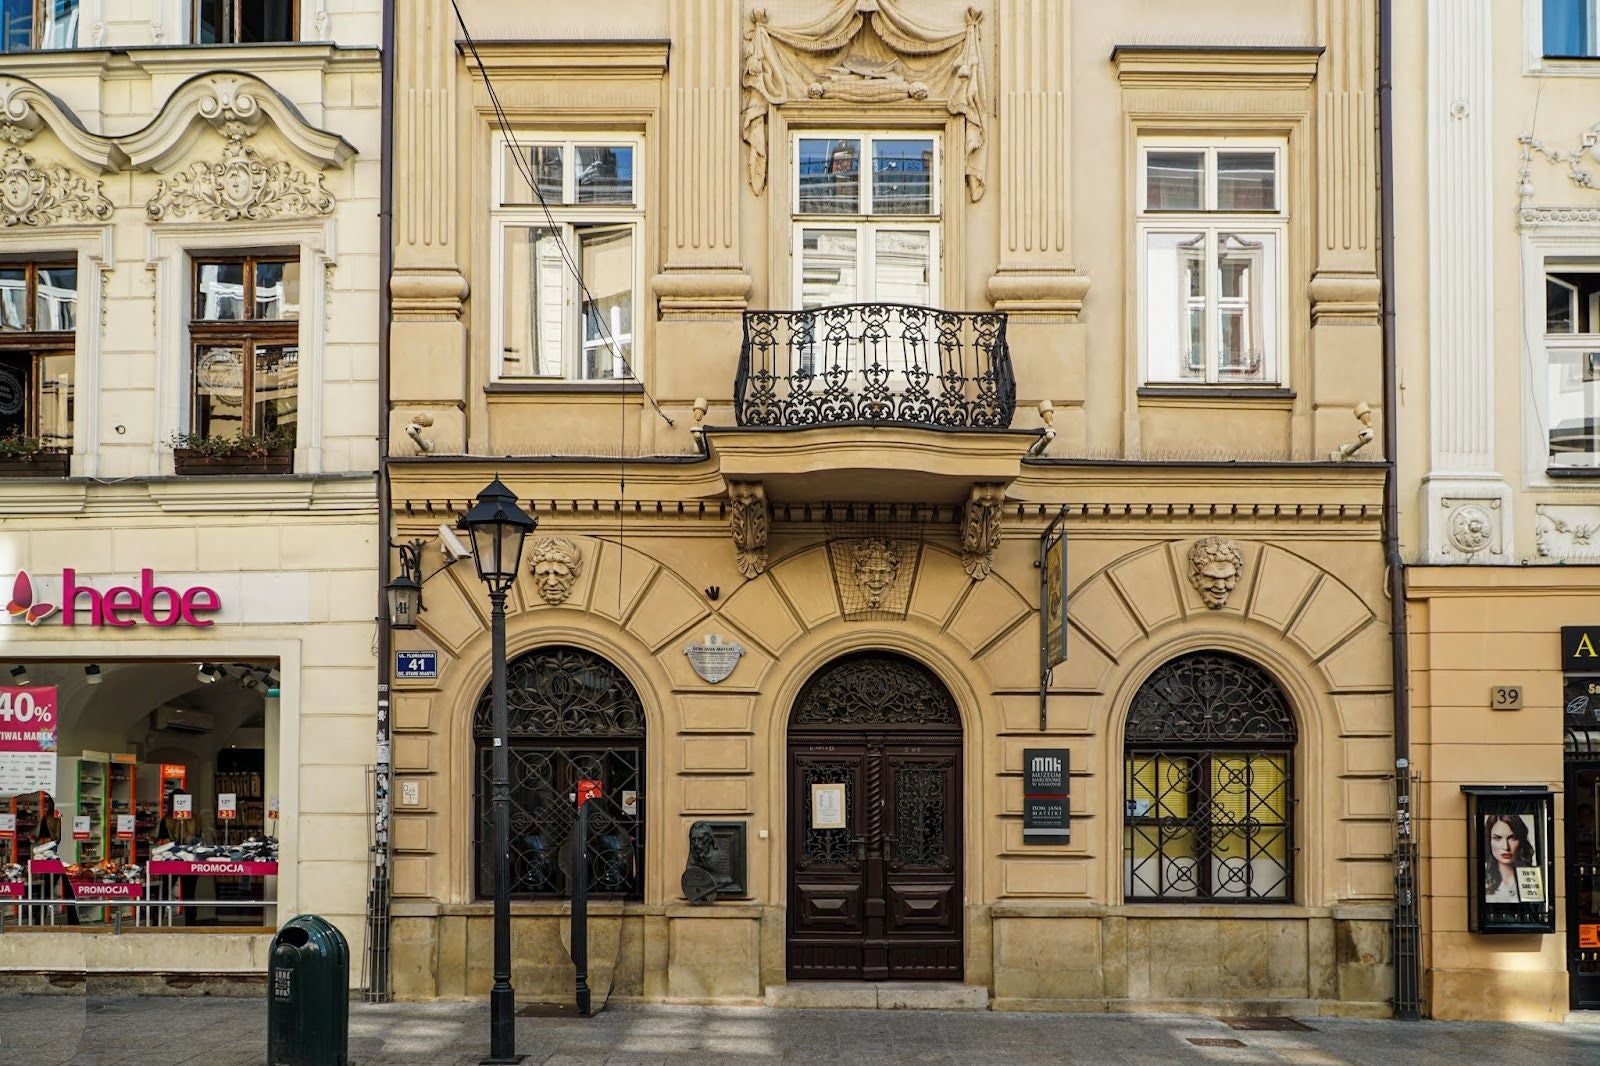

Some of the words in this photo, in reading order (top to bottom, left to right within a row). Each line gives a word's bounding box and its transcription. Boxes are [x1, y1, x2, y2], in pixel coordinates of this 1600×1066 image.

[62, 568, 222, 627] hebe
[408, 658, 425, 670] 41
[1497, 689, 1518, 704] 39
[24, 731, 53, 741] MAREK
[191, 863, 244, 872] PROMOCJA
[78, 885, 129, 894] PROMOCJA
